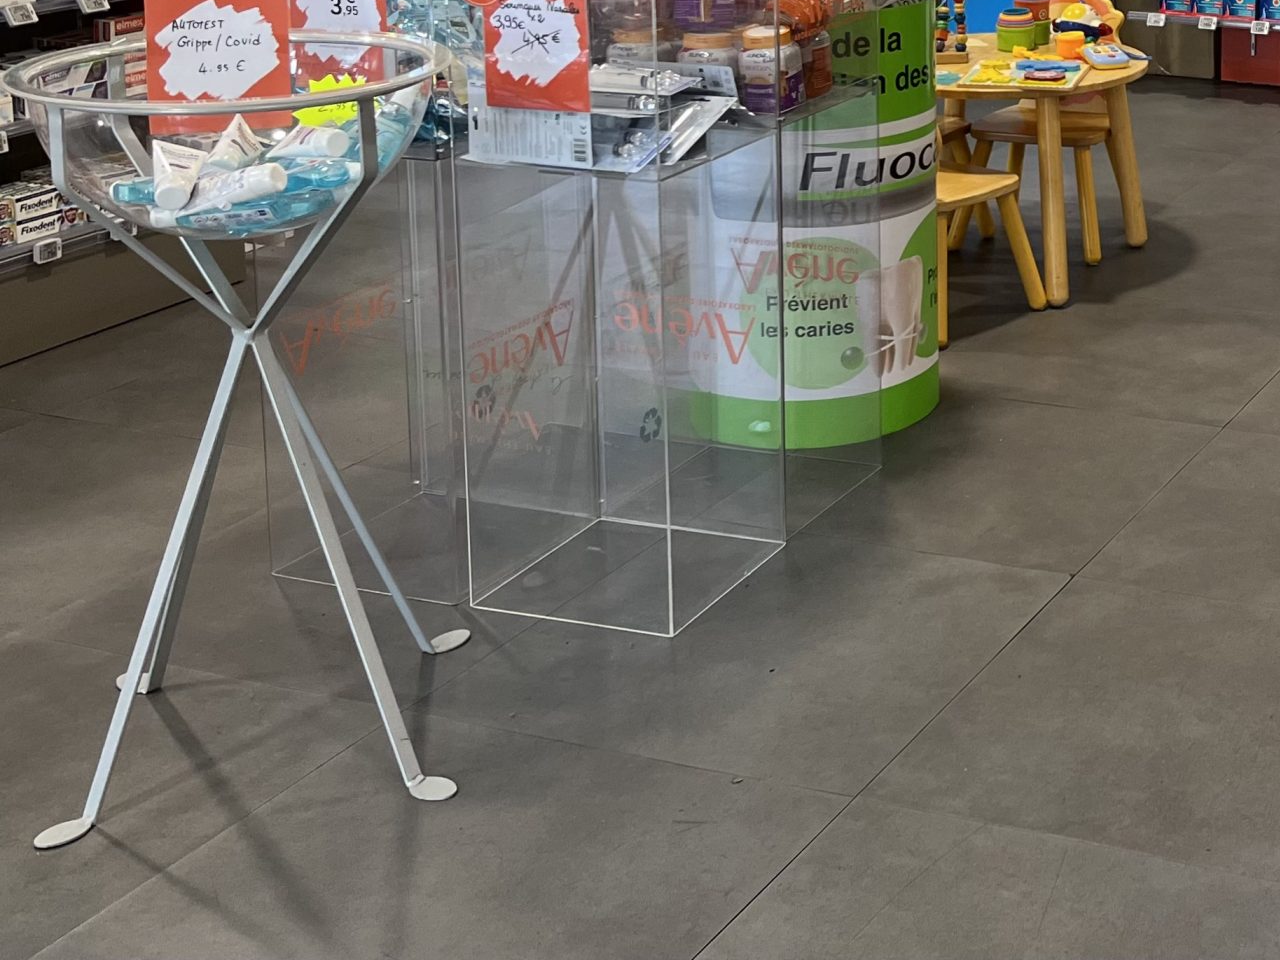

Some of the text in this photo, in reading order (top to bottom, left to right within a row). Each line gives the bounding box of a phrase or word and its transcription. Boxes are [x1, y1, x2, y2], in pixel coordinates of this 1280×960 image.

[116, 18, 143, 30] elmex
[832, 28, 902, 58] de la
[895, 64, 929, 92] des
[799, 139, 937, 191] Fluoc
[20, 195, 54, 213] Fixodent
[20, 218, 55, 235] Fixodent
[766, 294, 849, 313] Prévient
[760, 319, 855, 339] les caries
